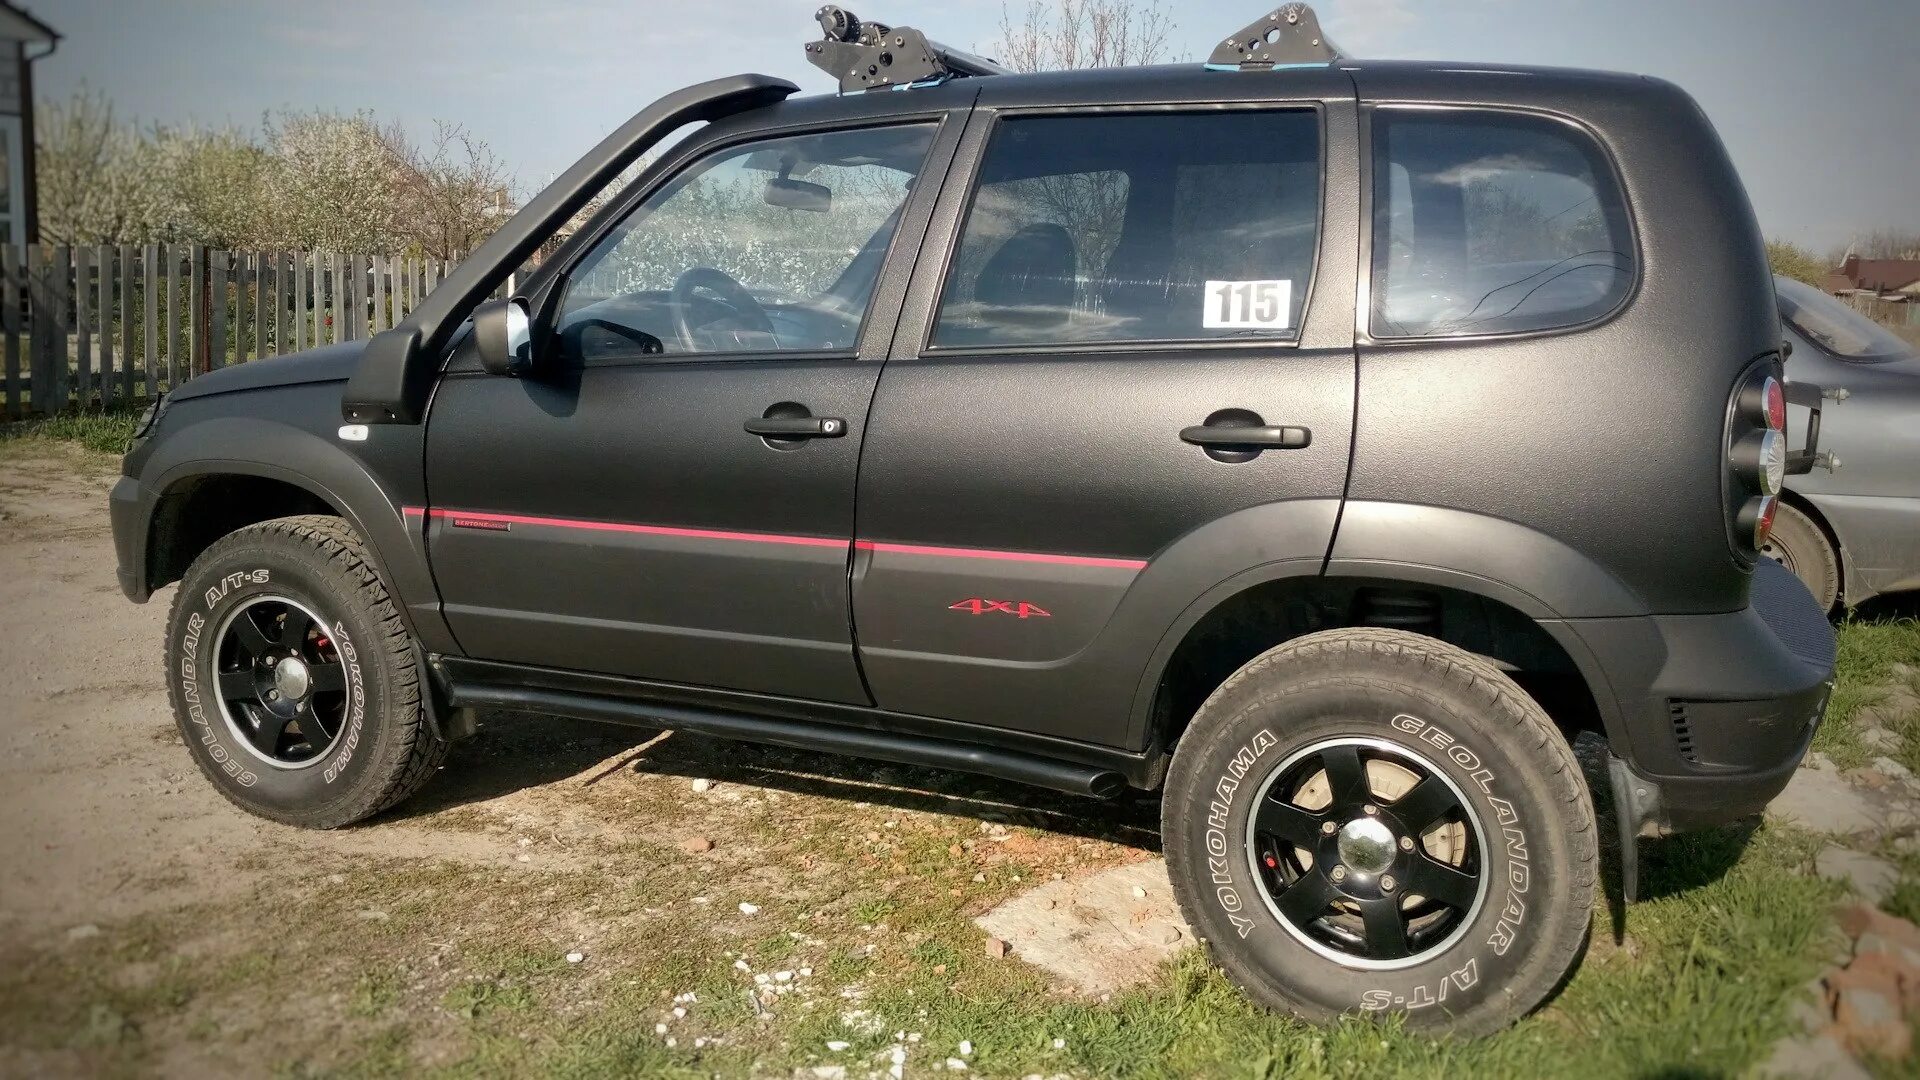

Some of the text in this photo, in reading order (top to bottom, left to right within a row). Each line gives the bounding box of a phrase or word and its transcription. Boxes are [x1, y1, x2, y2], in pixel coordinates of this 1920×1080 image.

[1215, 283, 1278, 322] 115
[182, 612, 258, 787] GEOLANDAR
[323, 621, 365, 784] YOKOHAMA
[1206, 729, 1278, 939] YOKOHAMA
[1391, 714, 1530, 957] GEOLANDAR
